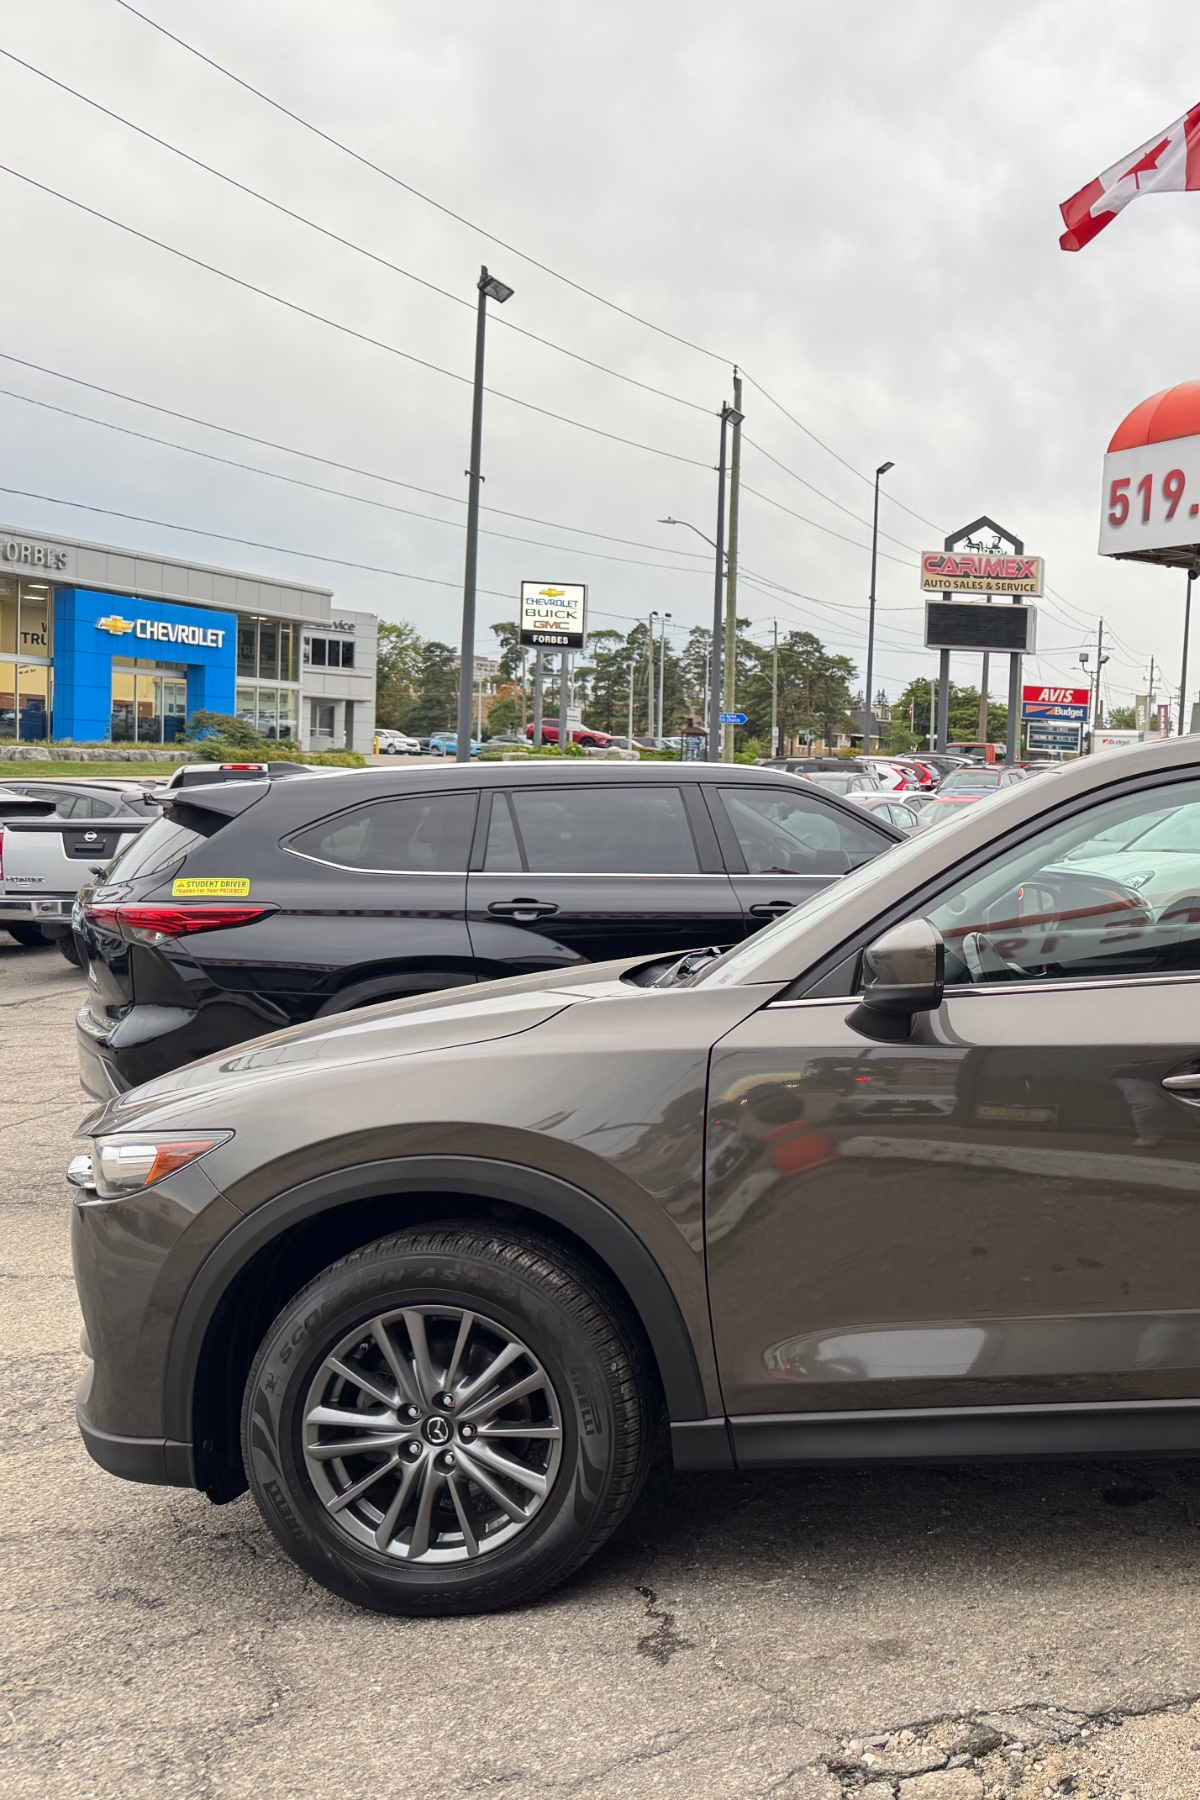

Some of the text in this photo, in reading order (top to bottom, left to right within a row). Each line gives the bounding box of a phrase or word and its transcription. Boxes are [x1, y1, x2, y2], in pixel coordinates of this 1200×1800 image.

[923, 555, 1038, 578] CARIMEX
[923, 579, 1036, 592] AUTO SALES & SERVICE
[526, 597, 579, 608] CHEVROLET
[525, 608, 578, 620] BUICK
[533, 620, 570, 630] GMC
[136, 618, 226, 648] CHEVROLET
[532, 634, 569, 645] FORBES
[1038, 688, 1074, 702] AVIS
[1054, 706, 1084, 718] Budget
[1108, 738, 1130, 746] Budget
[186, 880, 247, 888] STUDENT DRIVER
